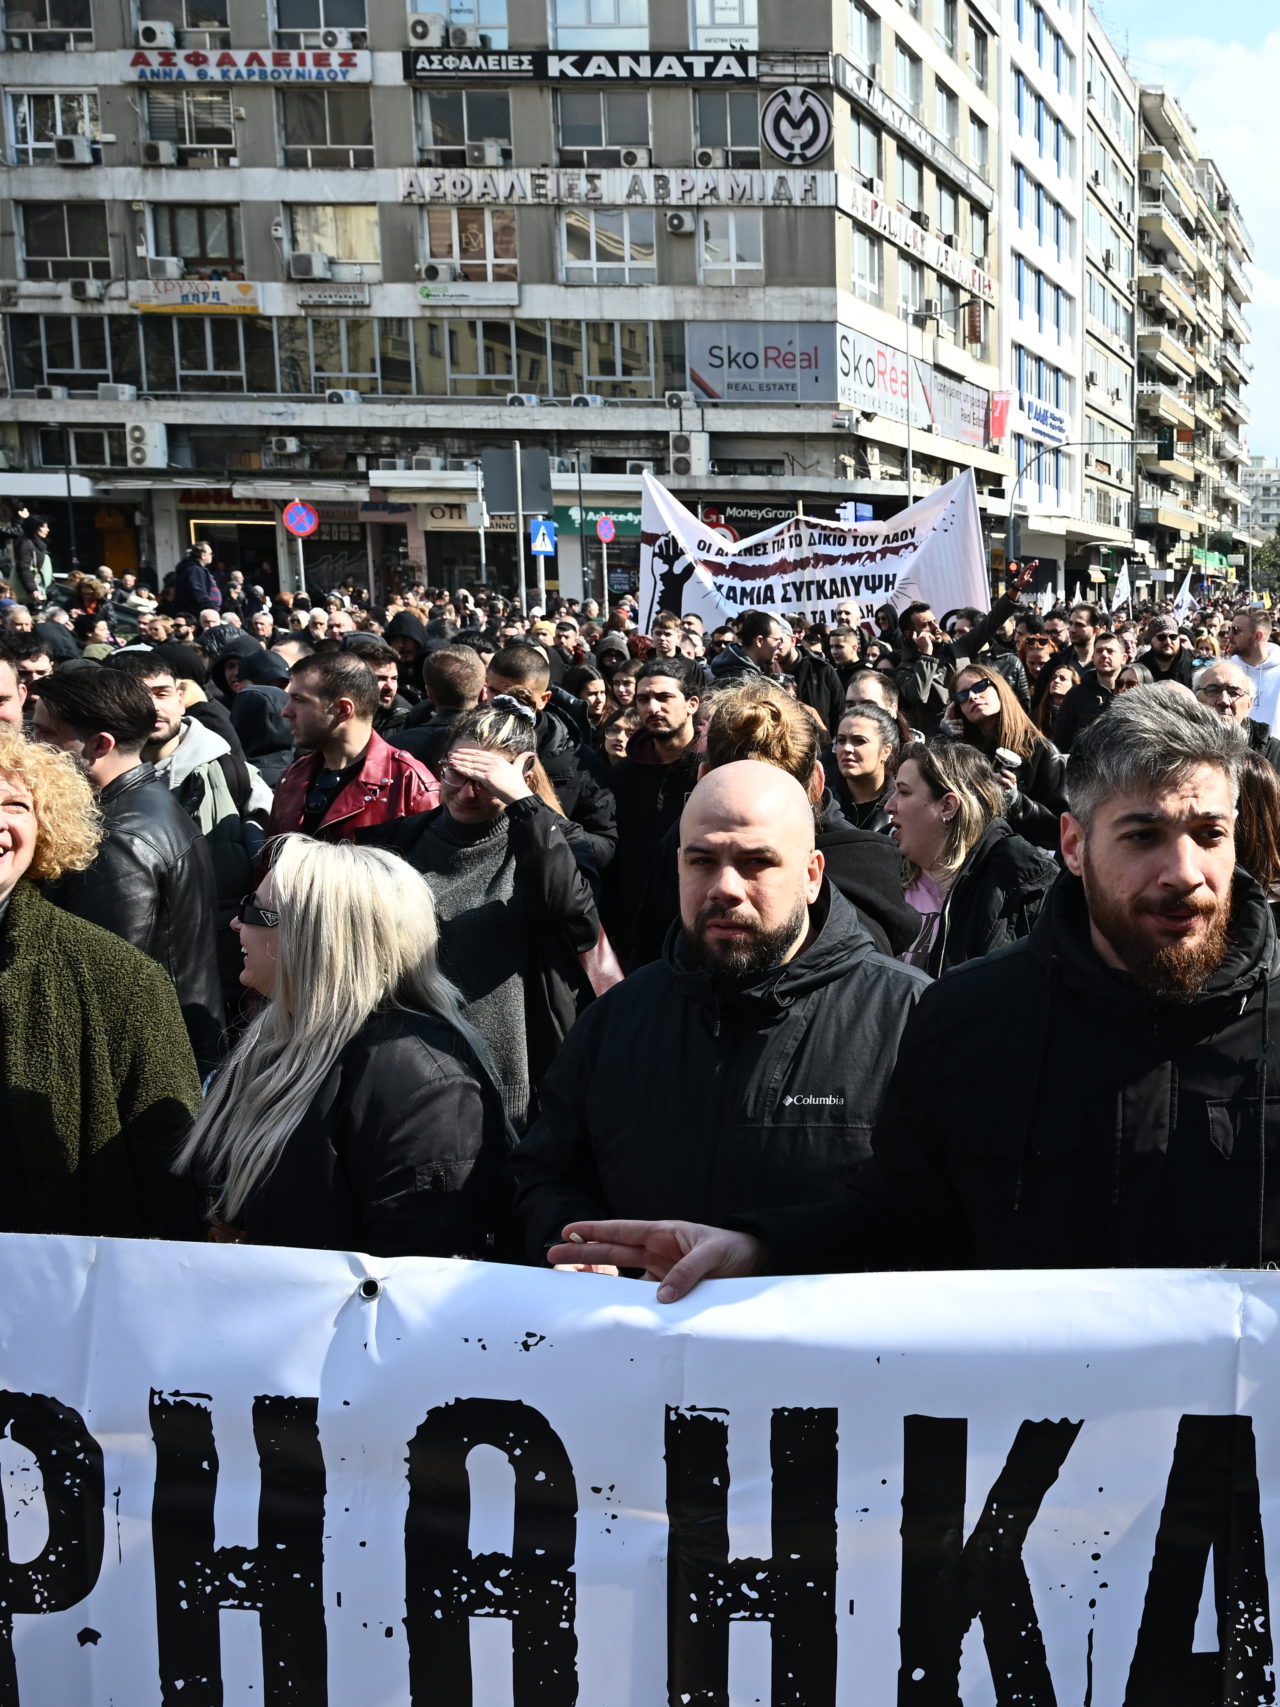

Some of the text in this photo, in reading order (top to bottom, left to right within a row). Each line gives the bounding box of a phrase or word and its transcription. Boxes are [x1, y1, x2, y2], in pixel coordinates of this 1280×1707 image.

[130, 51, 358, 67] ΑΣΦΑΛΕΙΕΣ
[415, 55, 533, 71] ΑΣΦΑΛΕΙΕΣ
[138, 69, 186, 81] ΑΝΝΑ
[220, 69, 350, 81] ΚΑΡΒΟΥΝΙΔΟΥ
[402, 172, 818, 201] ΑΣΦΑΛΕΙΕΣ ΑΒΡΑΜΙΔΗ
[727, 383, 797, 392] REAL ESTATE
[884, 403, 919, 424] ΓΡΑΦΙΑ
[725, 506, 797, 520] MoneyGram
[696, 539, 713, 554] ΟΙ
[771, 538, 785, 554] ΓΙΑ
[788, 533, 803, 548] ΤΟ
[808, 532, 847, 547] ΔΙΚΙΟ
[852, 534, 879, 547] ΤΟΥ
[881, 527, 916, 545] ΛΑΟΥ
[713, 573, 897, 606] ΚΑΜΙΑ ΣΥΓΚΑΛΥΨΗ
[810, 610, 826, 625] ΤΑ
[793, 1094, 844, 1105] Columbia
